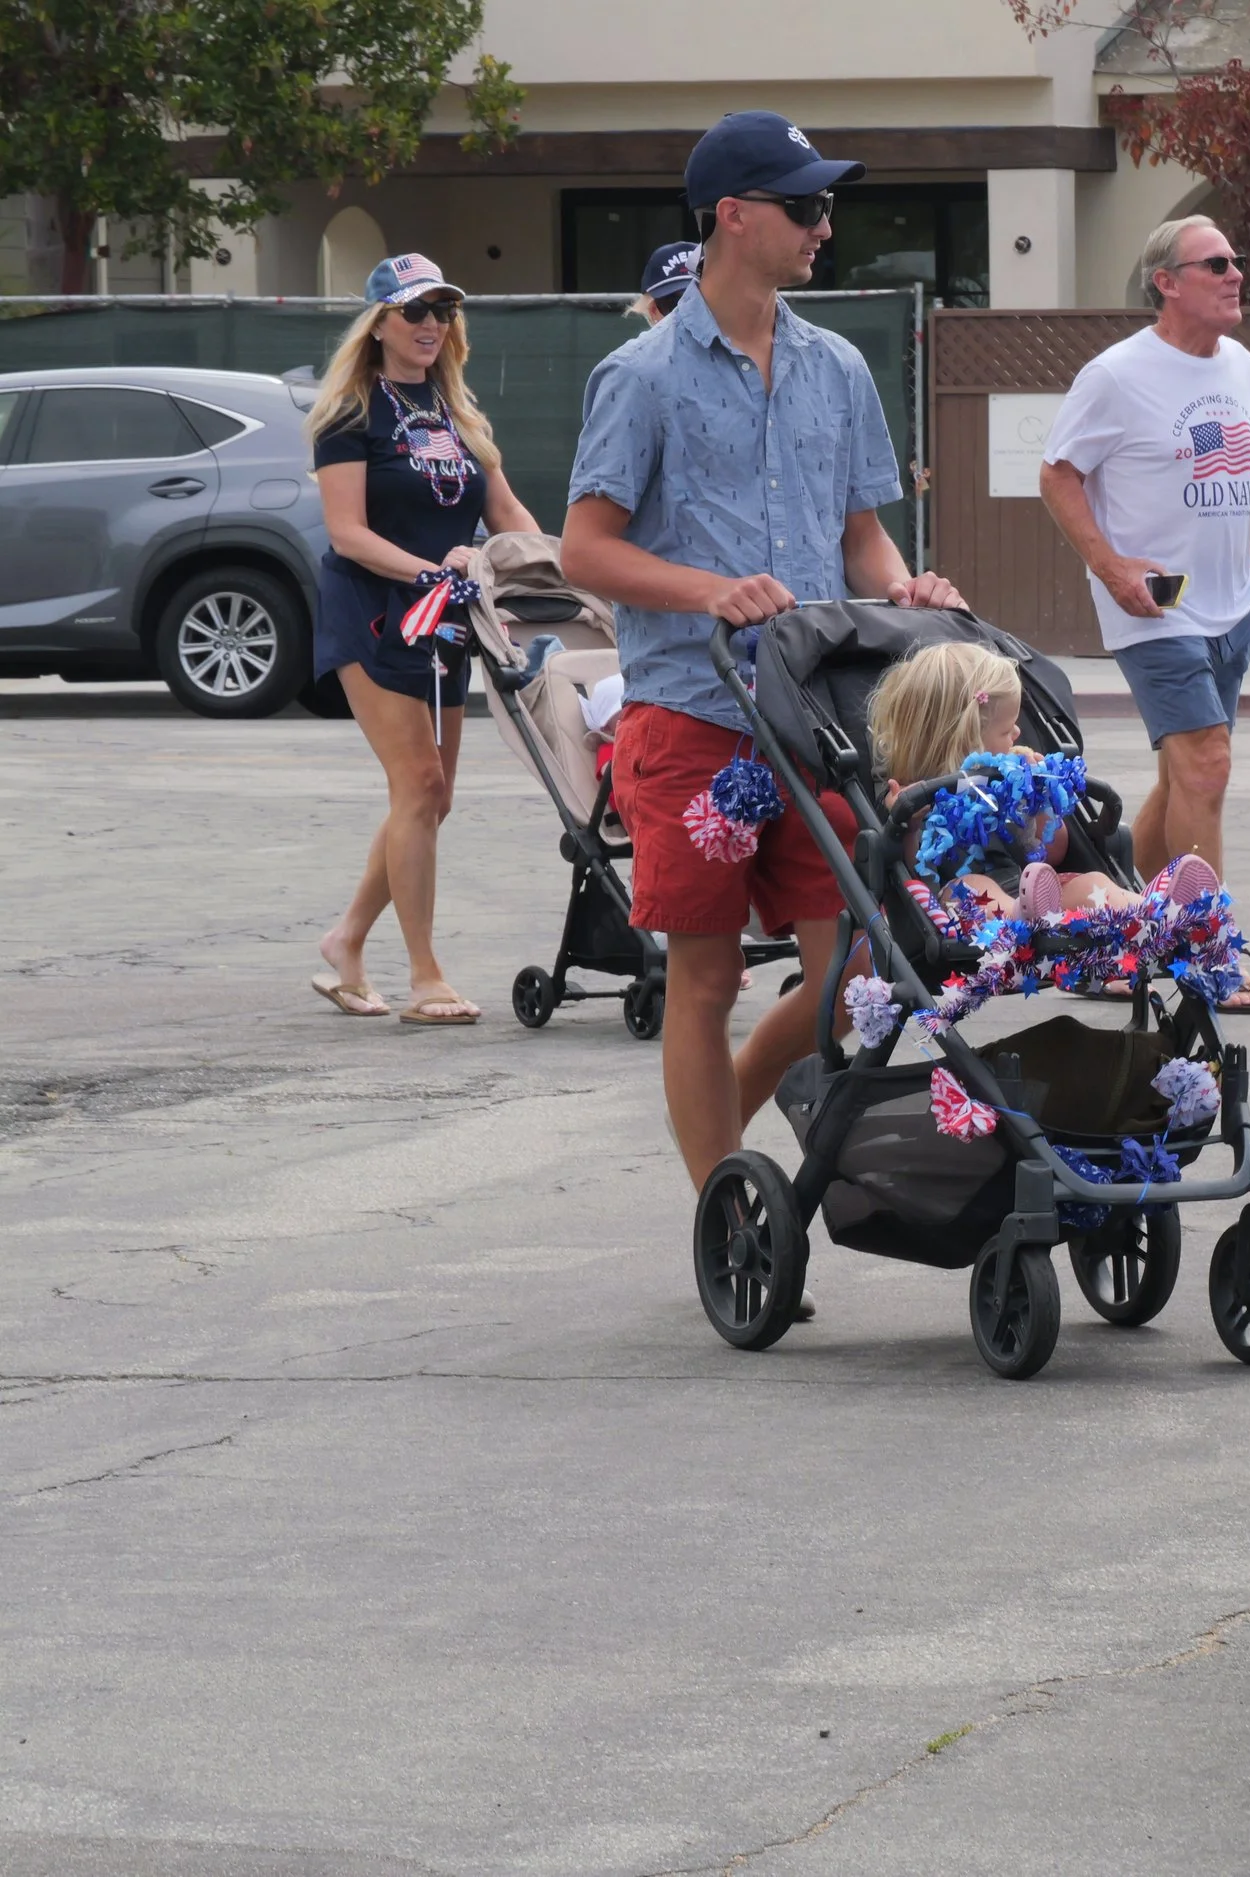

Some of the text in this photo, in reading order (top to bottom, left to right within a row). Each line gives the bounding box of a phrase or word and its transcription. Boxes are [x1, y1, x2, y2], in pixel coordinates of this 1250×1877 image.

[662, 251, 694, 276] AME
[1172, 394, 1222, 438] CELEBRATING
[1174, 447, 1193, 460] 20
[1183, 482, 1224, 508] OLD
